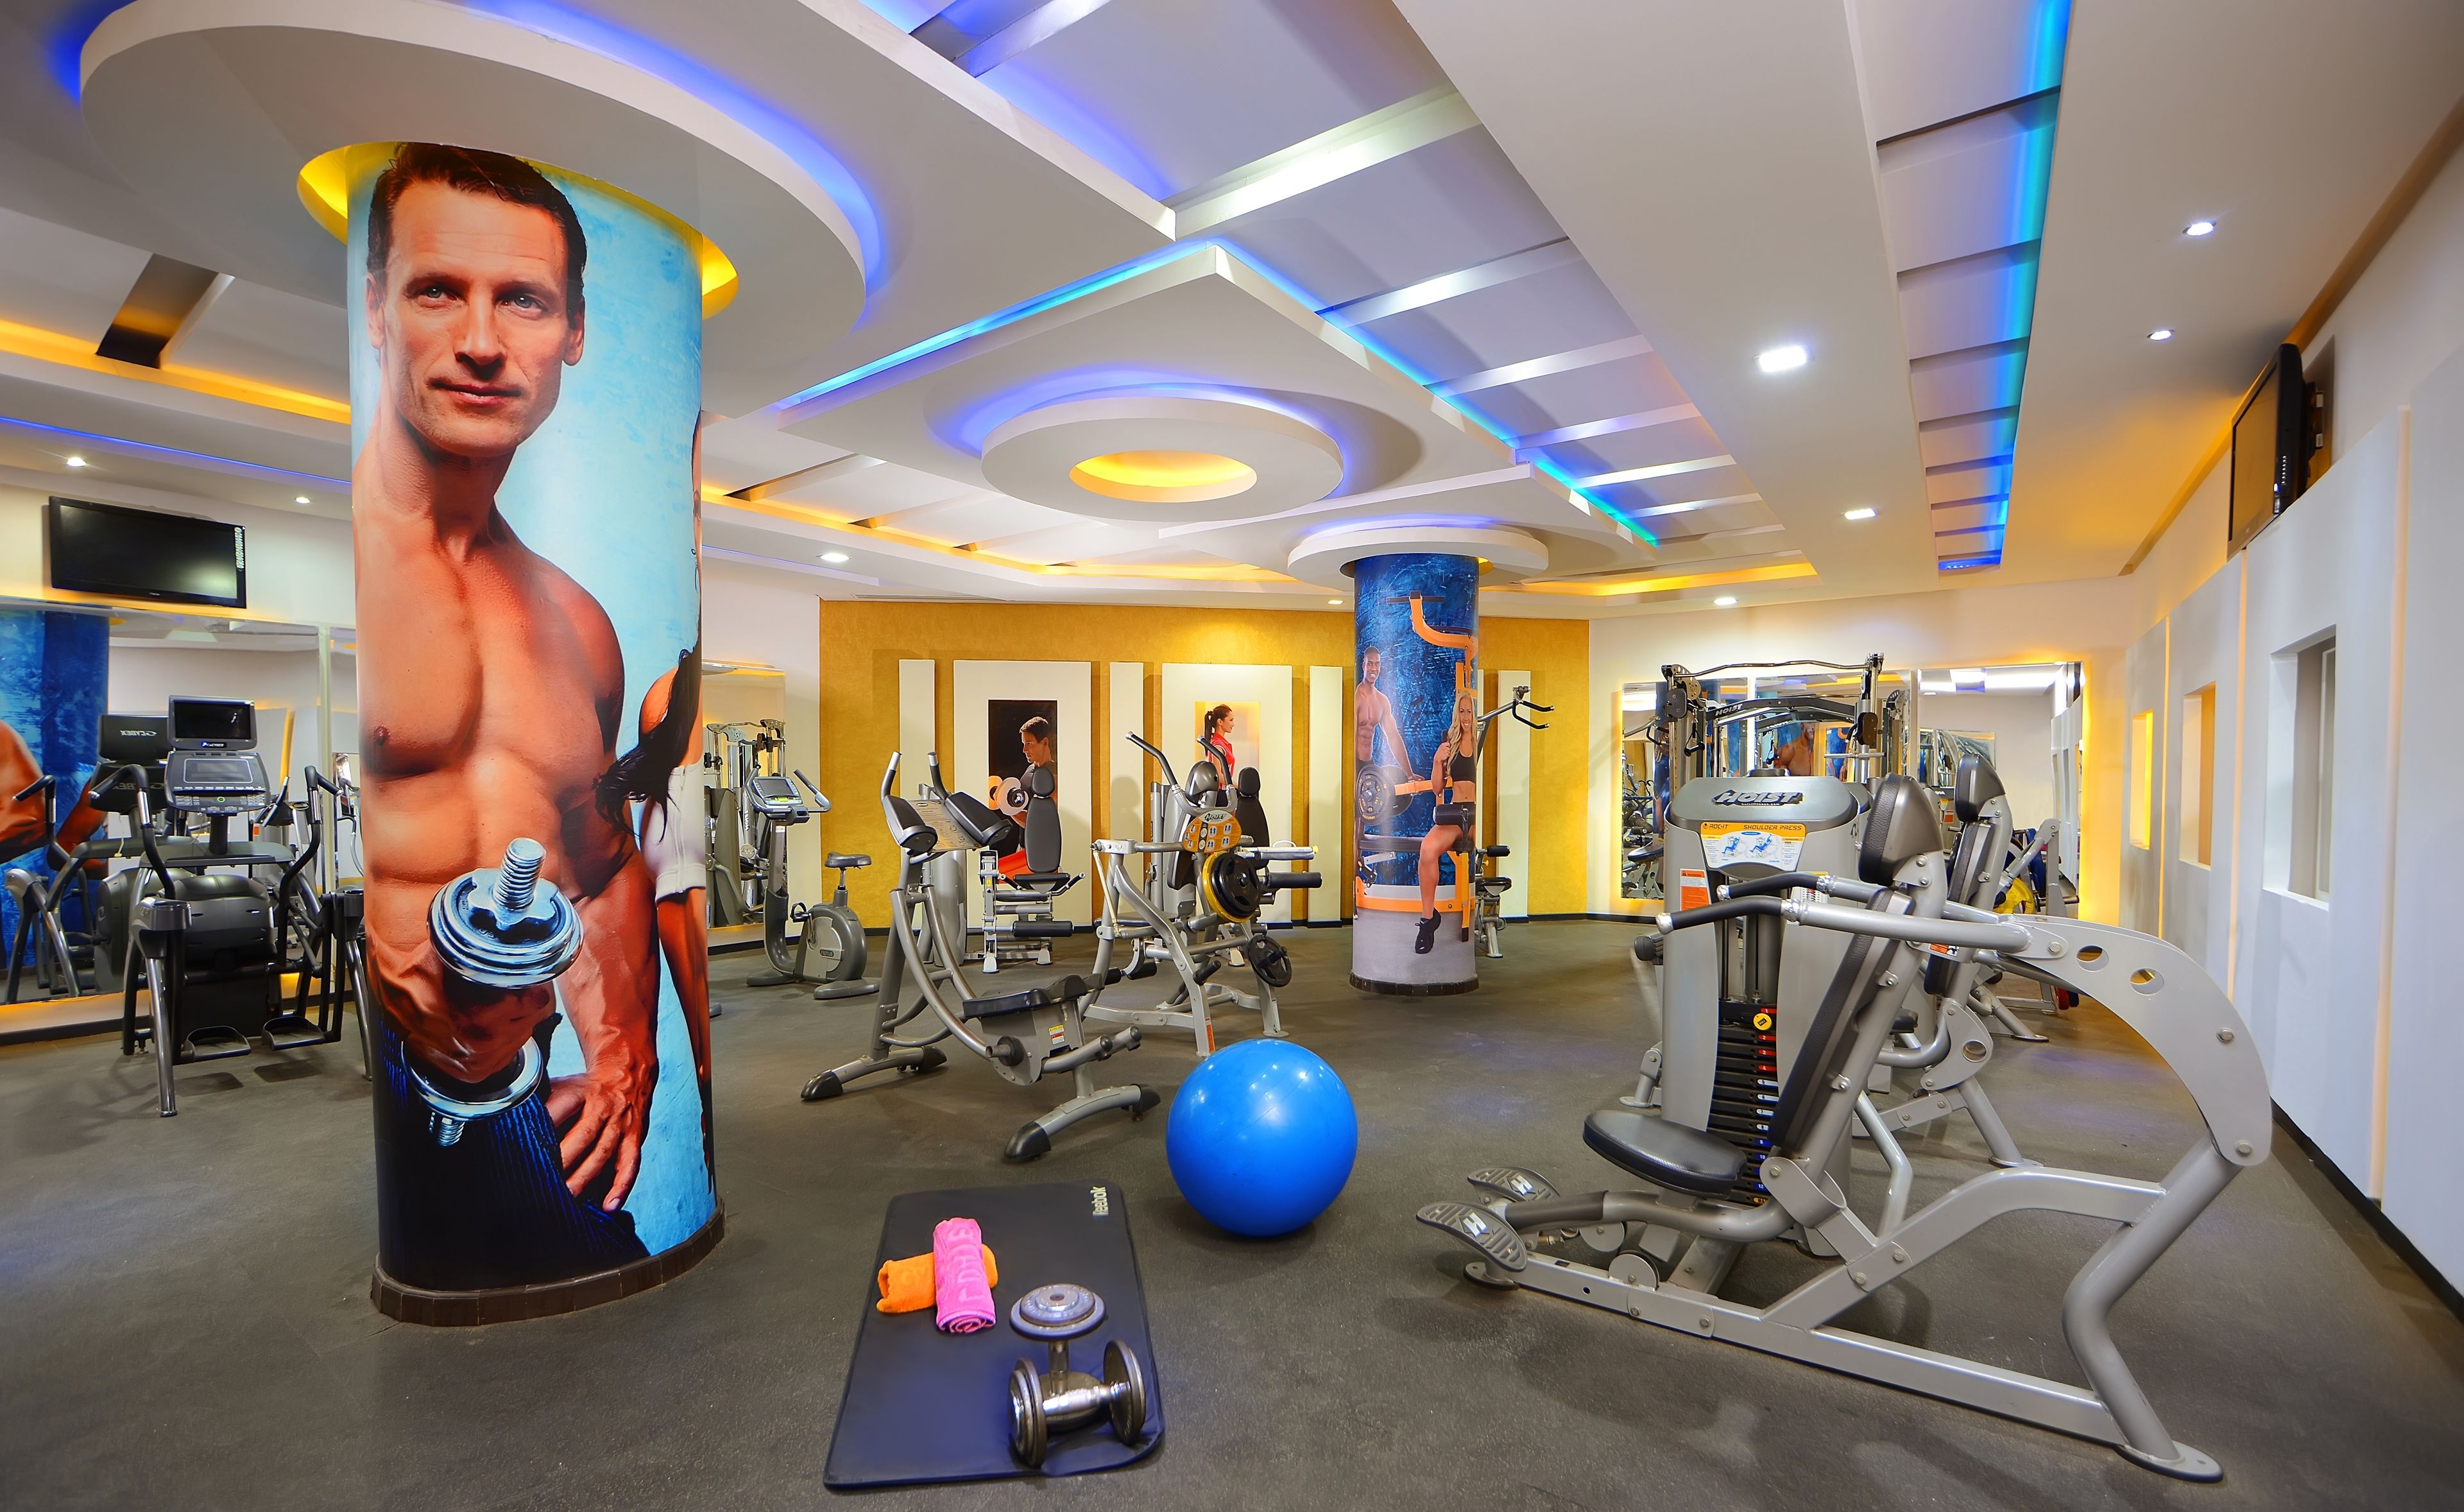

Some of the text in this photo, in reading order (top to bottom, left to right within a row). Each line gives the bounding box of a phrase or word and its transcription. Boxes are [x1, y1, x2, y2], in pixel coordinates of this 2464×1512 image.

[1715, 704, 1743, 716] HOIST
[1715, 791, 1802, 803] HOIST
[1204, 813, 1227, 821] HOIST
[1090, 1186, 1109, 1216] Reebok
